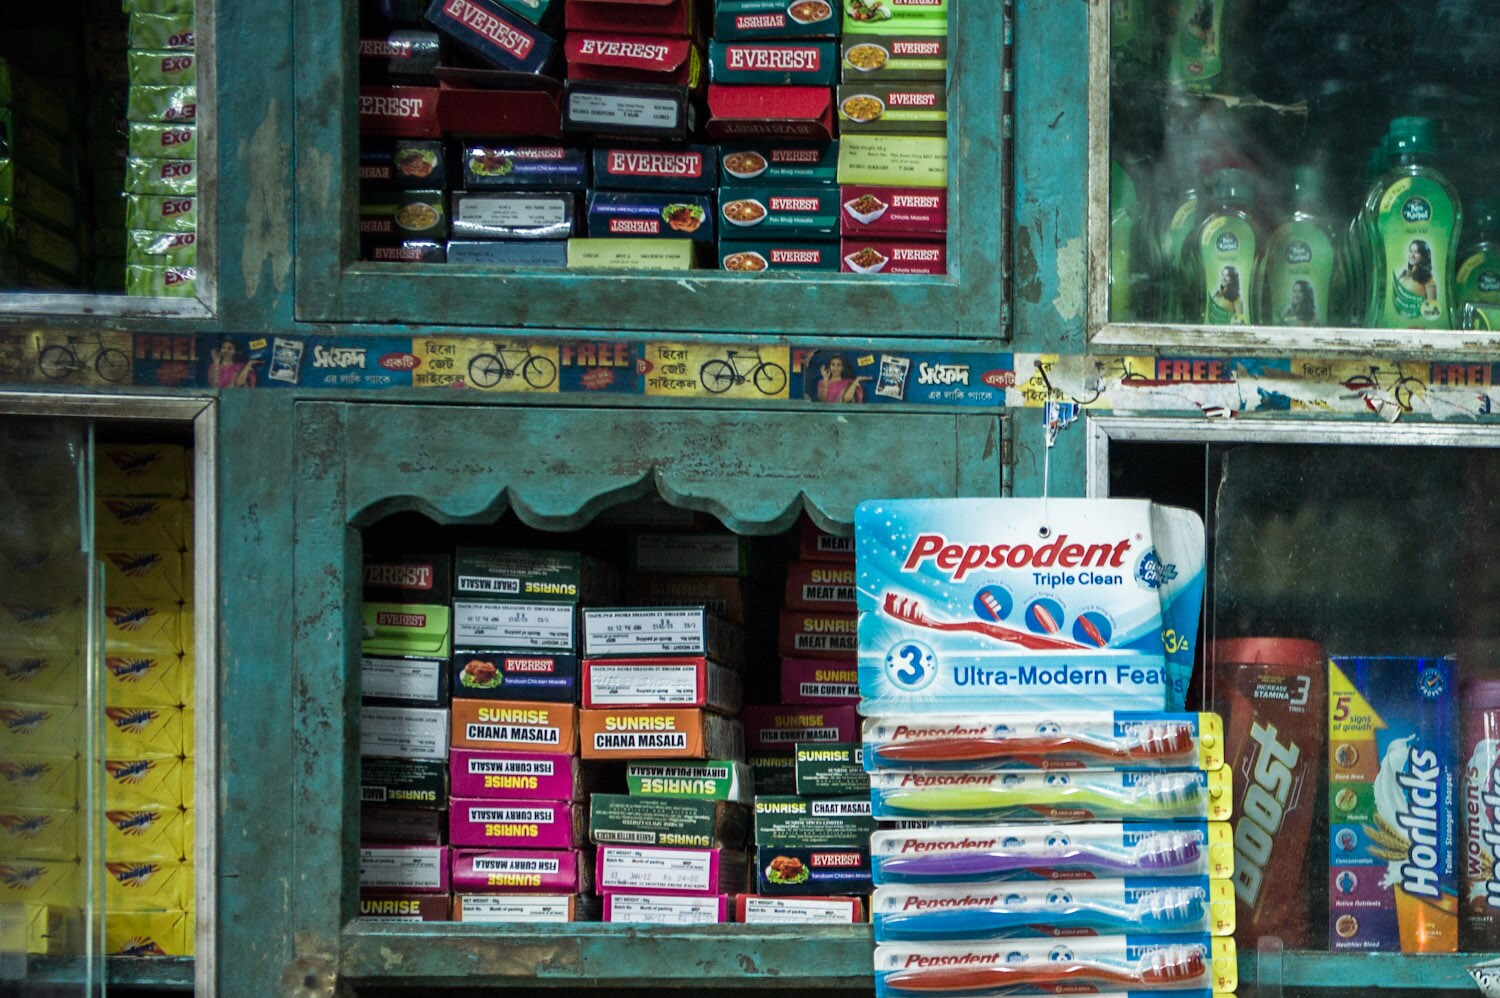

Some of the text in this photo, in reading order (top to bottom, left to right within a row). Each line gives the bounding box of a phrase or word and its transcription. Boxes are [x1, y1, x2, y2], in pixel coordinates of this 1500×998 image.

[446, 0, 532, 56] EVEREST
[737, 15, 785, 28] EVEREST
[580, 39, 669, 62] EVEREST
[893, 42, 940, 55] EVEREST
[161, 56, 192, 73] Exo
[730, 48, 817, 69] EVEREST
[161, 130, 192, 147] Exo
[611, 152, 699, 175] EVEREST
[161, 163, 192, 179] Exo
[771, 199, 819, 211] EVEREST
[893, 196, 939, 209] EVEREST
[611, 219, 659, 233] EVEREST
[893, 249, 939, 262] EVEREST
[561, 342, 630, 367] FREE
[1158, 359, 1223, 381] FREE
[903, 533, 1131, 580] Pepsodent
[460, 578, 518, 592] CHAAT MASALA
[1033, 571, 1123, 587] Triple Clean
[525, 581, 576, 595] SUNRISE
[806, 587, 836, 600] MEAT
[379, 613, 425, 627] EVEREST
[506, 659, 553, 672] EVEREST
[896, 643, 926, 686] 3
[953, 664, 1108, 688] Ultra-Modern
[1256, 684, 1288, 692] INCREASE
[1290, 674, 1311, 706] 3
[1253, 691, 1290, 701] STAMINA
[478, 707, 549, 724] SUNRISE
[1332, 697, 1372, 725] 5 signs
[775, 715, 824, 726] SUNRISE
[1333, 722, 1373, 733] of growth
[468, 725, 557, 743] CHANA MASALA
[892, 724, 987, 740] Pepsodent
[797, 751, 849, 763] SUNRISE
[470, 761, 552, 774] FISH CURRY MASALA
[630, 766, 664, 777] MASALA
[693, 767, 727, 778] BIRYANI
[484, 775, 538, 788] SUNRISE
[640, 778, 716, 795] SUNRISE
[388, 789, 437, 801] SUNRISE
[756, 803, 871, 815] SUNRISE CHAAT MASALA
[1401, 746, 1441, 897] Horlicks
[1467, 766, 1481, 878] women's
[485, 824, 539, 837] SUNRISE
[814, 854, 860, 866] EVEREST
[903, 894, 998, 911] Pepsodent
